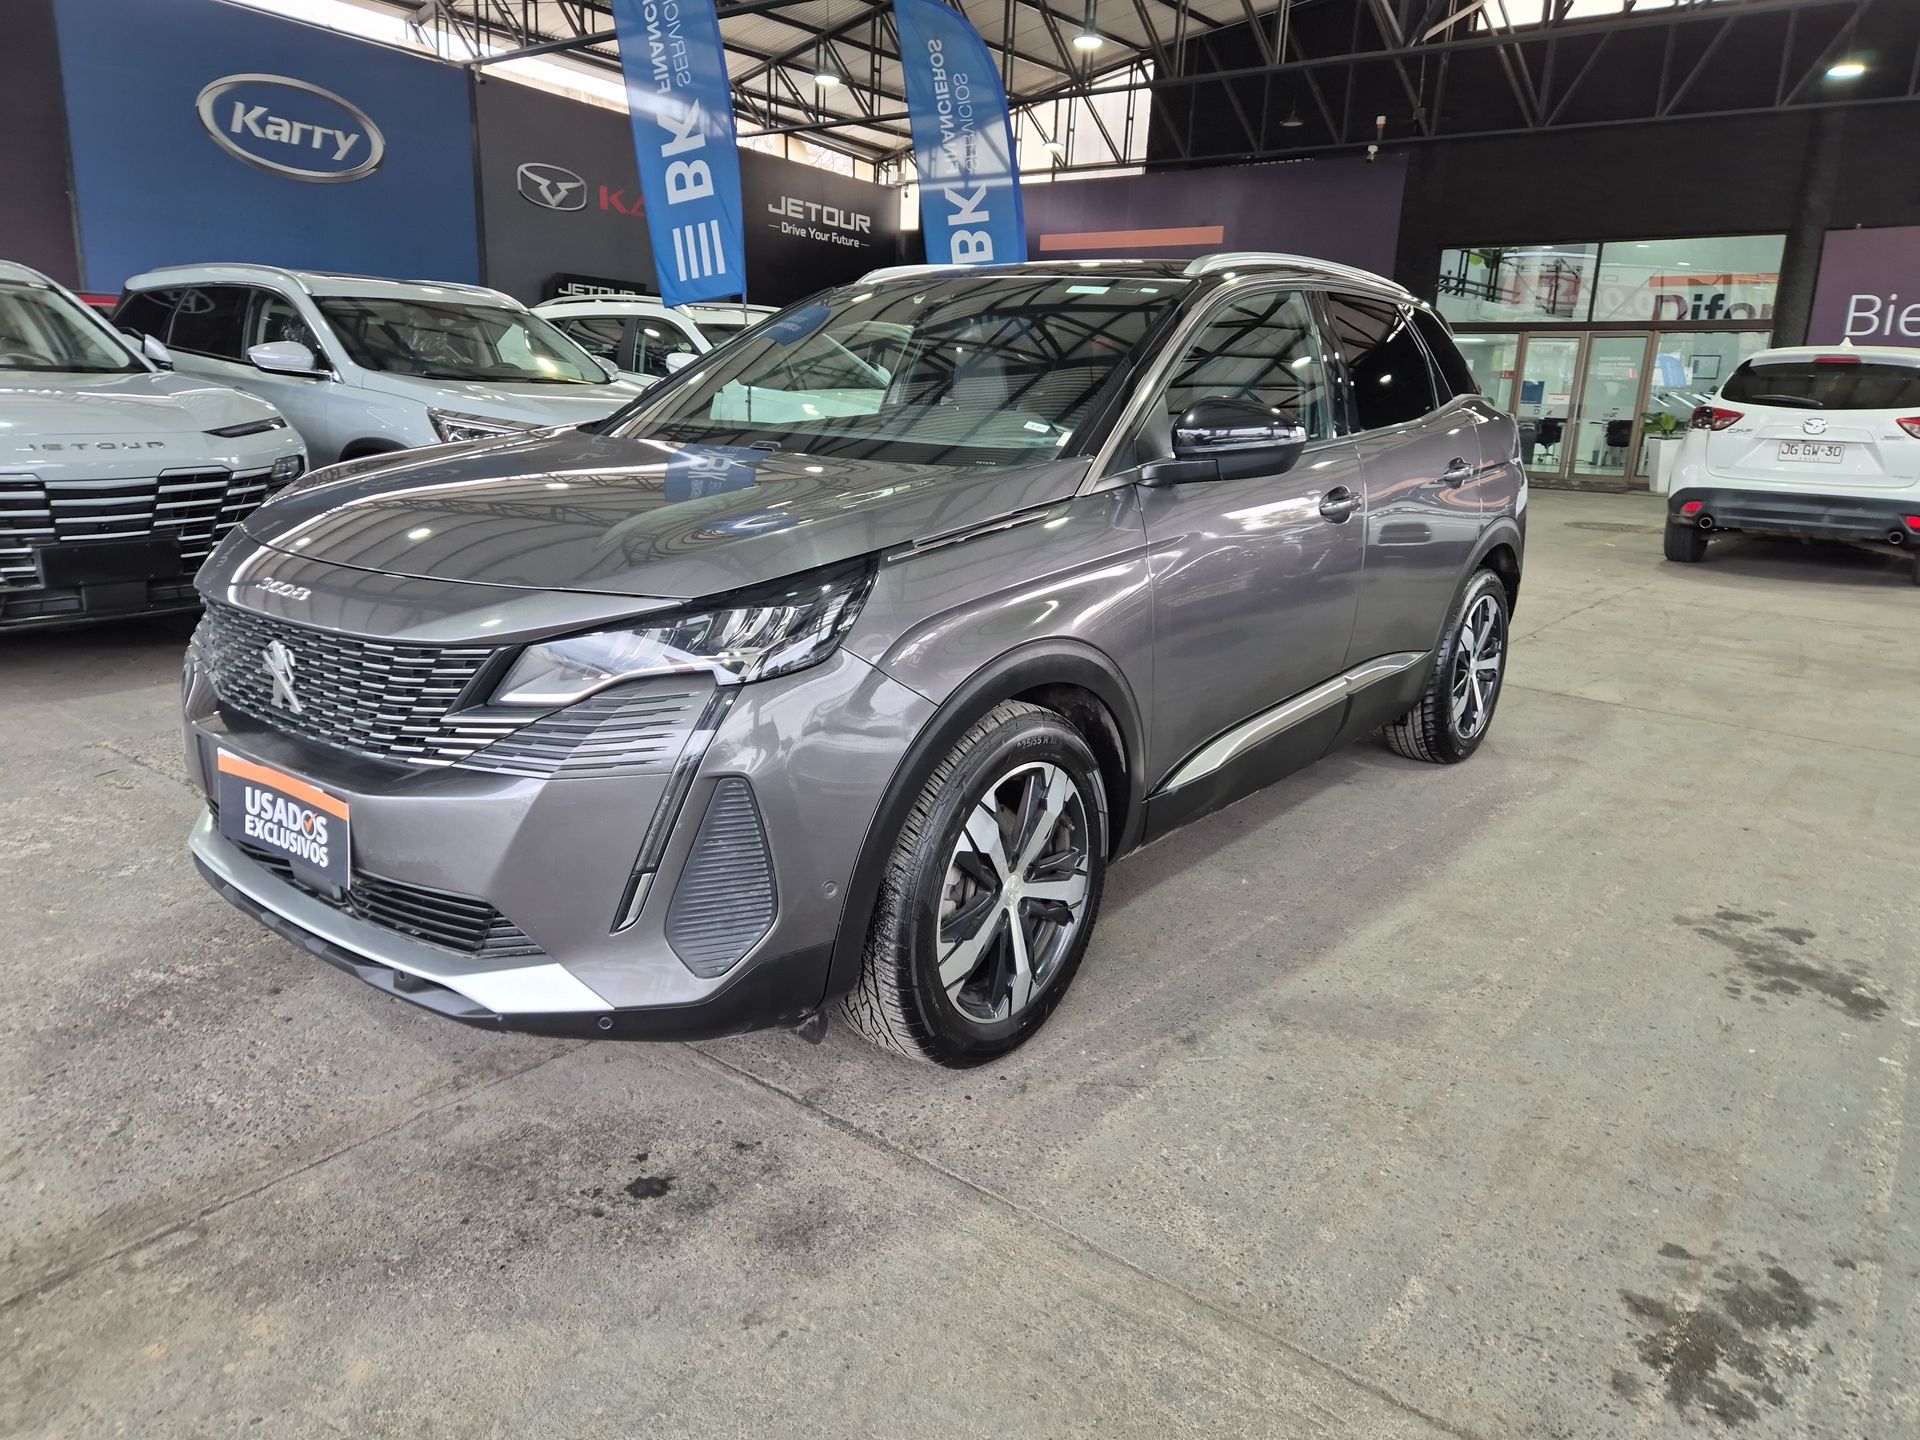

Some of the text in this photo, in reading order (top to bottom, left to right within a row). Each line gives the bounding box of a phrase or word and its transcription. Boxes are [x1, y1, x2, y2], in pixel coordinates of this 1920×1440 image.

[230, 101, 360, 161] Karry
[767, 195, 871, 234] JETOUR
[781, 221, 860, 248] Drive Your Future
[256, 576, 312, 600] 3008
[245, 786, 329, 845] USADOS
[245, 814, 329, 868] EXCLUSIVOS
